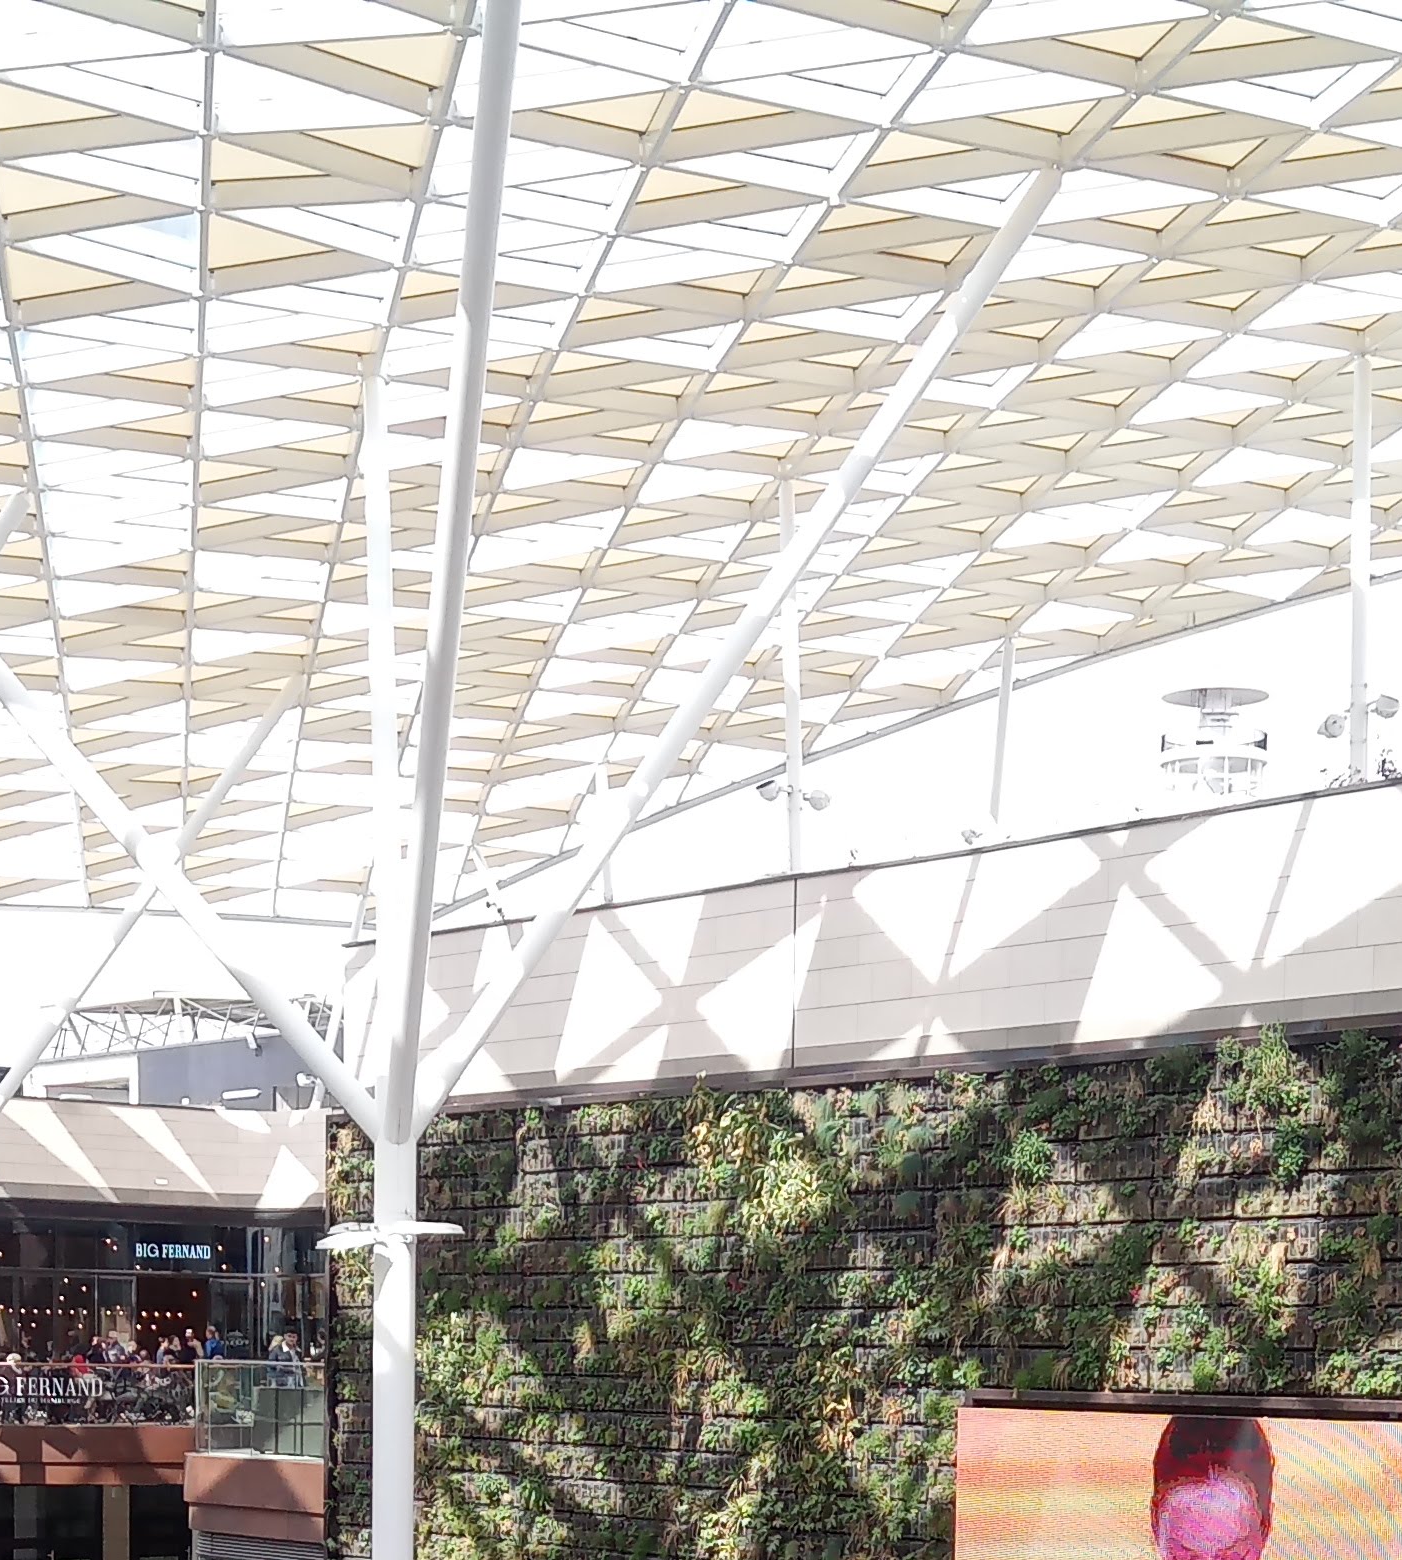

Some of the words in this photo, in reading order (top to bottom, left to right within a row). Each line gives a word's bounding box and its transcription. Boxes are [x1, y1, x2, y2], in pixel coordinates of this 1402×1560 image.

[135, 1243, 159, 1258] BIG
[162, 1244, 211, 1259] FERNAND
[16, 1376, 103, 1397] FERNAND
